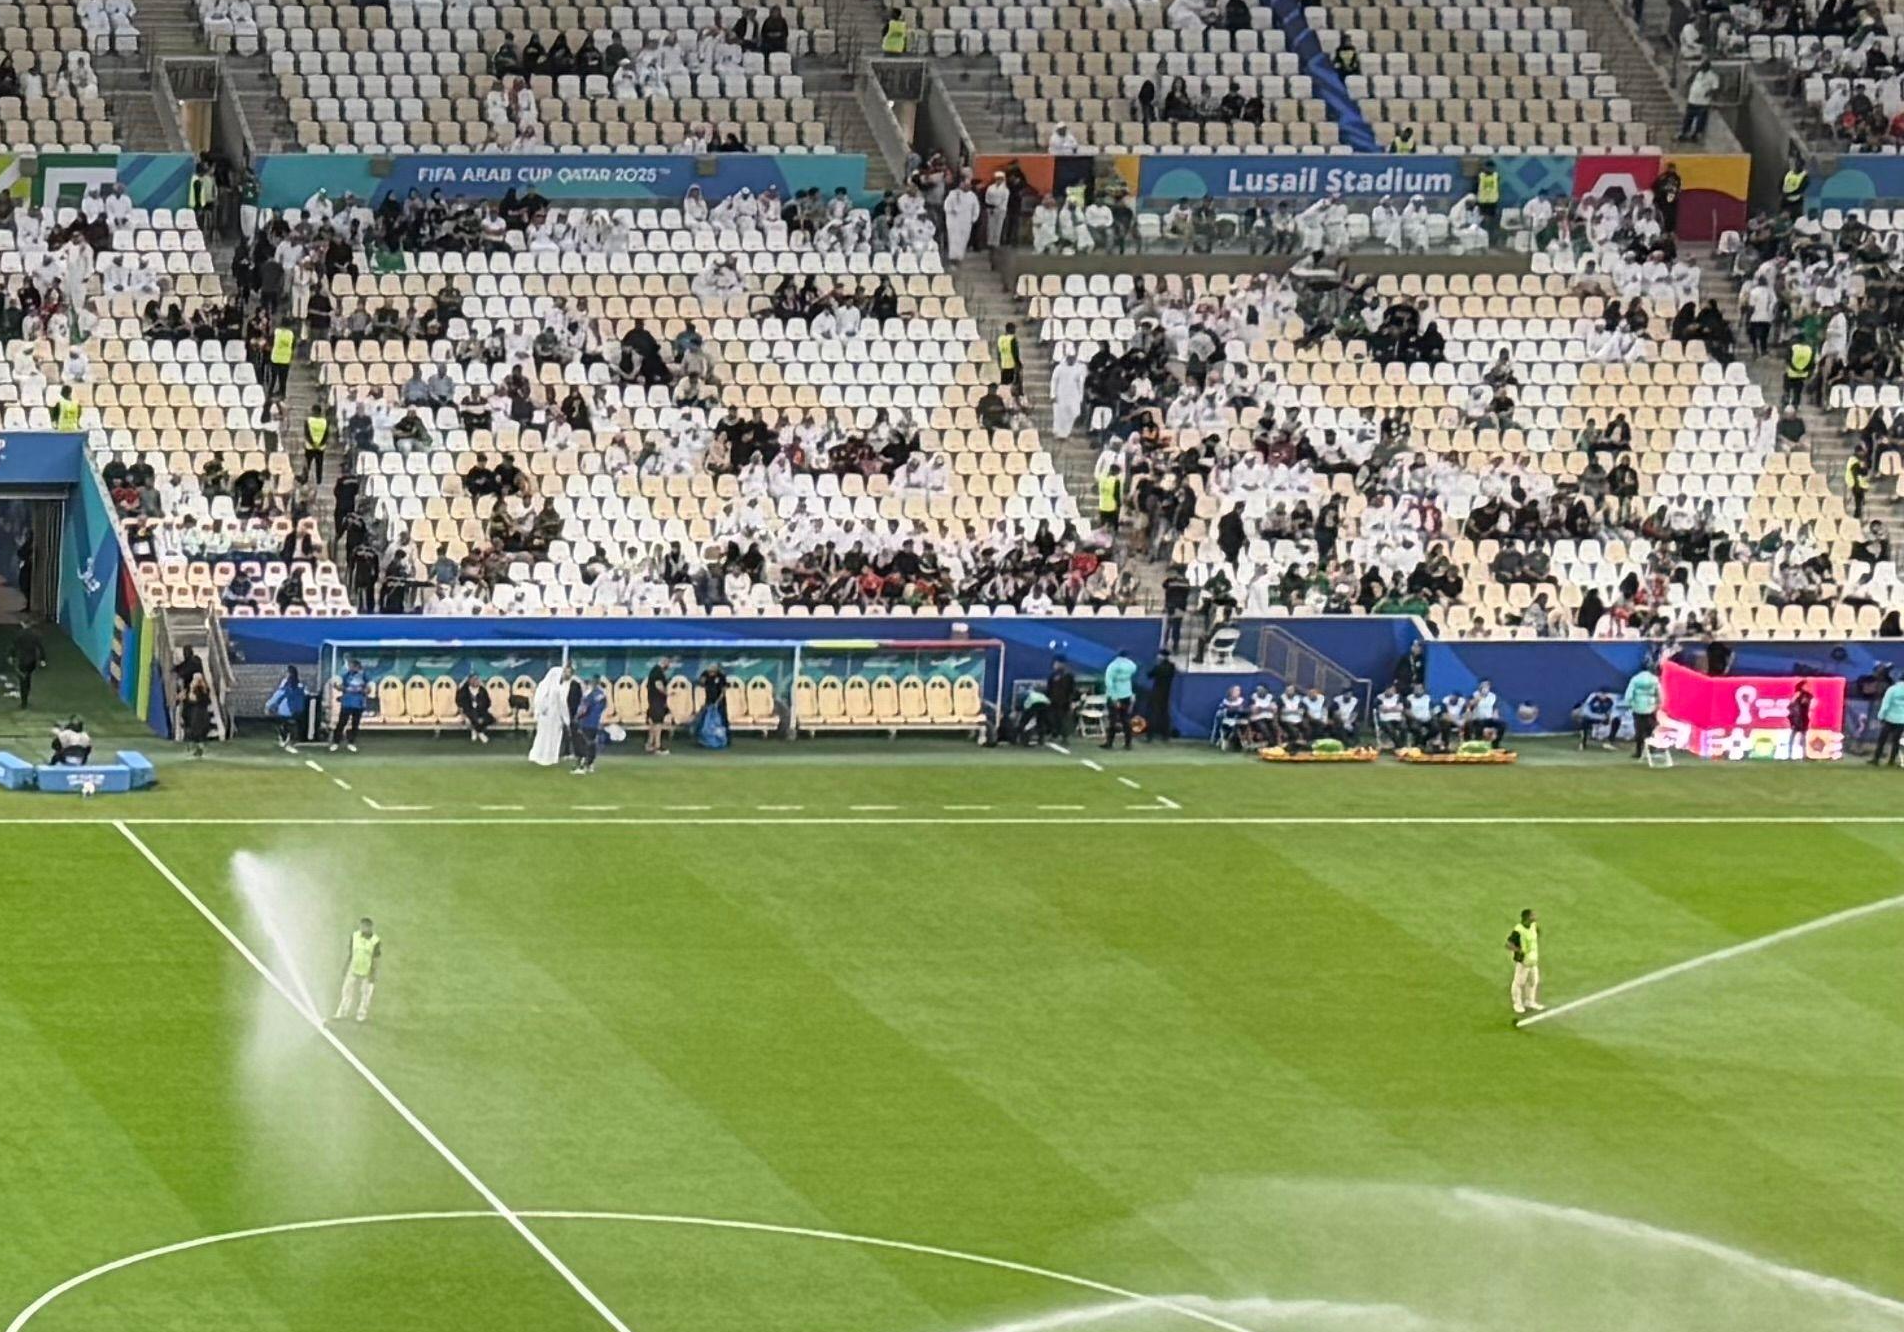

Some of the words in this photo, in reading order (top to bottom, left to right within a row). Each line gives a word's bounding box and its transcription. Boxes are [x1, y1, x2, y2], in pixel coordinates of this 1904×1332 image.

[417, 166, 456, 182] FIFA
[461, 167, 512, 182] ARAB
[517, 167, 553, 182] CUP
[557, 168, 610, 185] QATAR
[1228, 167, 1318, 193] Lusail
[1324, 166, 1453, 193] Stadium
